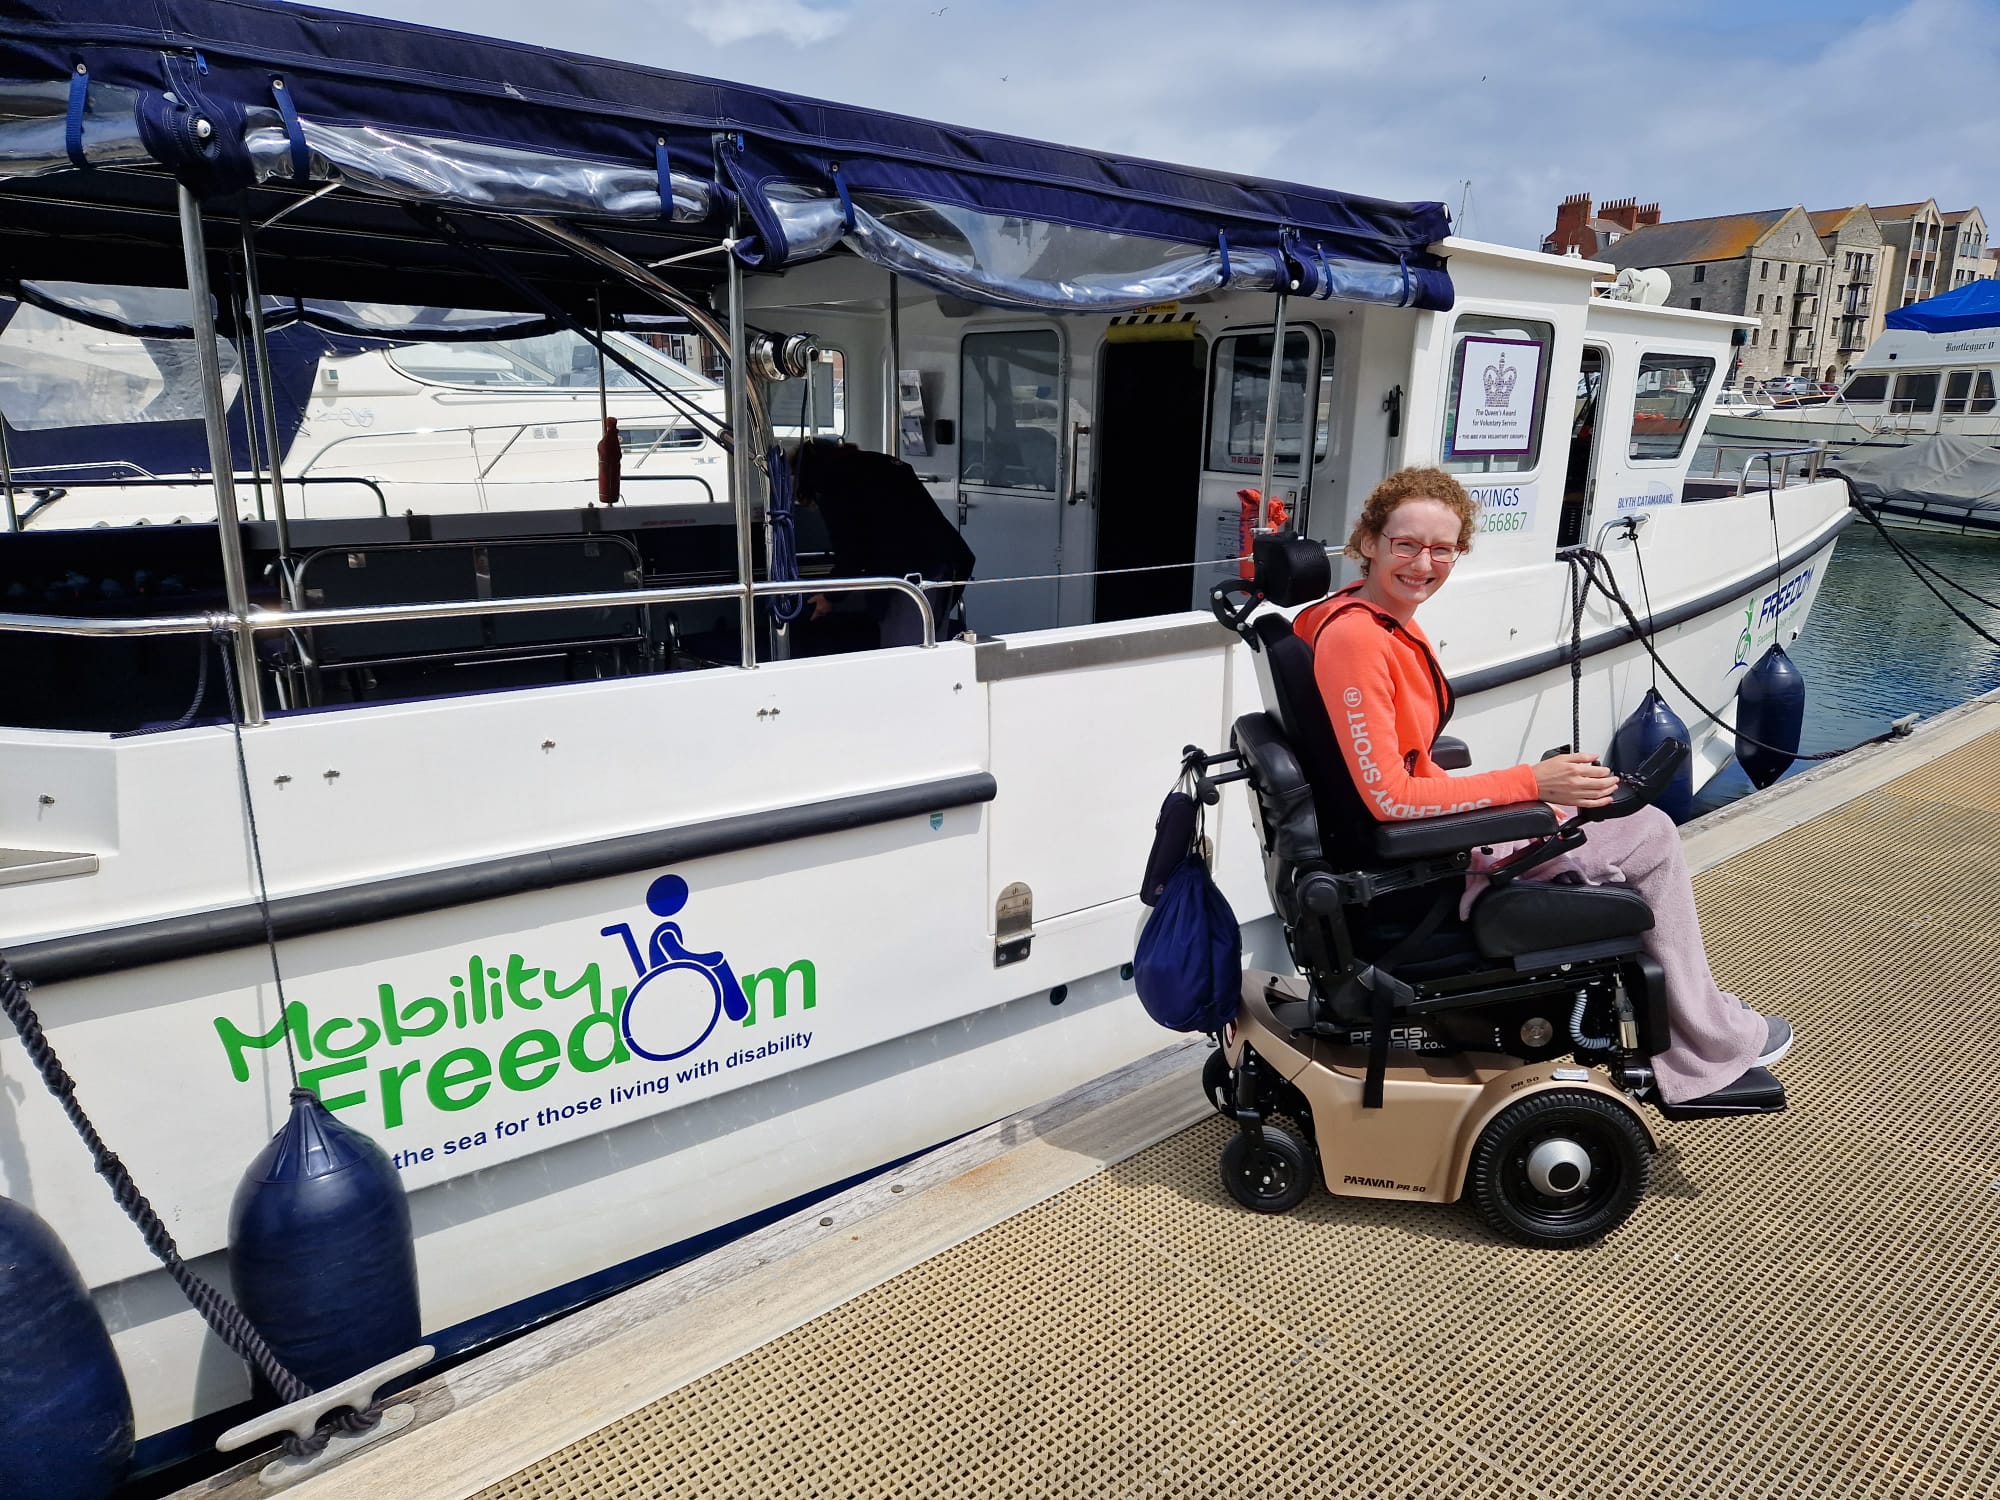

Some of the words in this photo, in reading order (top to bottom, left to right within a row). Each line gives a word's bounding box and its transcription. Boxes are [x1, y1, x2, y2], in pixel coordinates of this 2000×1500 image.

[1470, 487, 1520, 507] OKINGS
[1617, 496, 1636, 508] BLYTH
[1637, 494, 1674, 507] CATAMARANS
[1480, 512, 1528, 532] 266867
[1346, 711, 1382, 784] SPORT
[213, 953, 601, 1083] Mobility
[392, 1146, 434, 1170] the
[442, 1131, 488, 1155] sea
[494, 1117, 530, 1139] for
[536, 1096, 602, 1127] those
[610, 1075, 670, 1105] living
[676, 1059, 720, 1084] with
[726, 1031, 813, 1069] disability
[1343, 1175, 1394, 1189] PARAVAN
[1396, 1183, 1411, 1191] PR
[1412, 1185, 1427, 1193] 50
